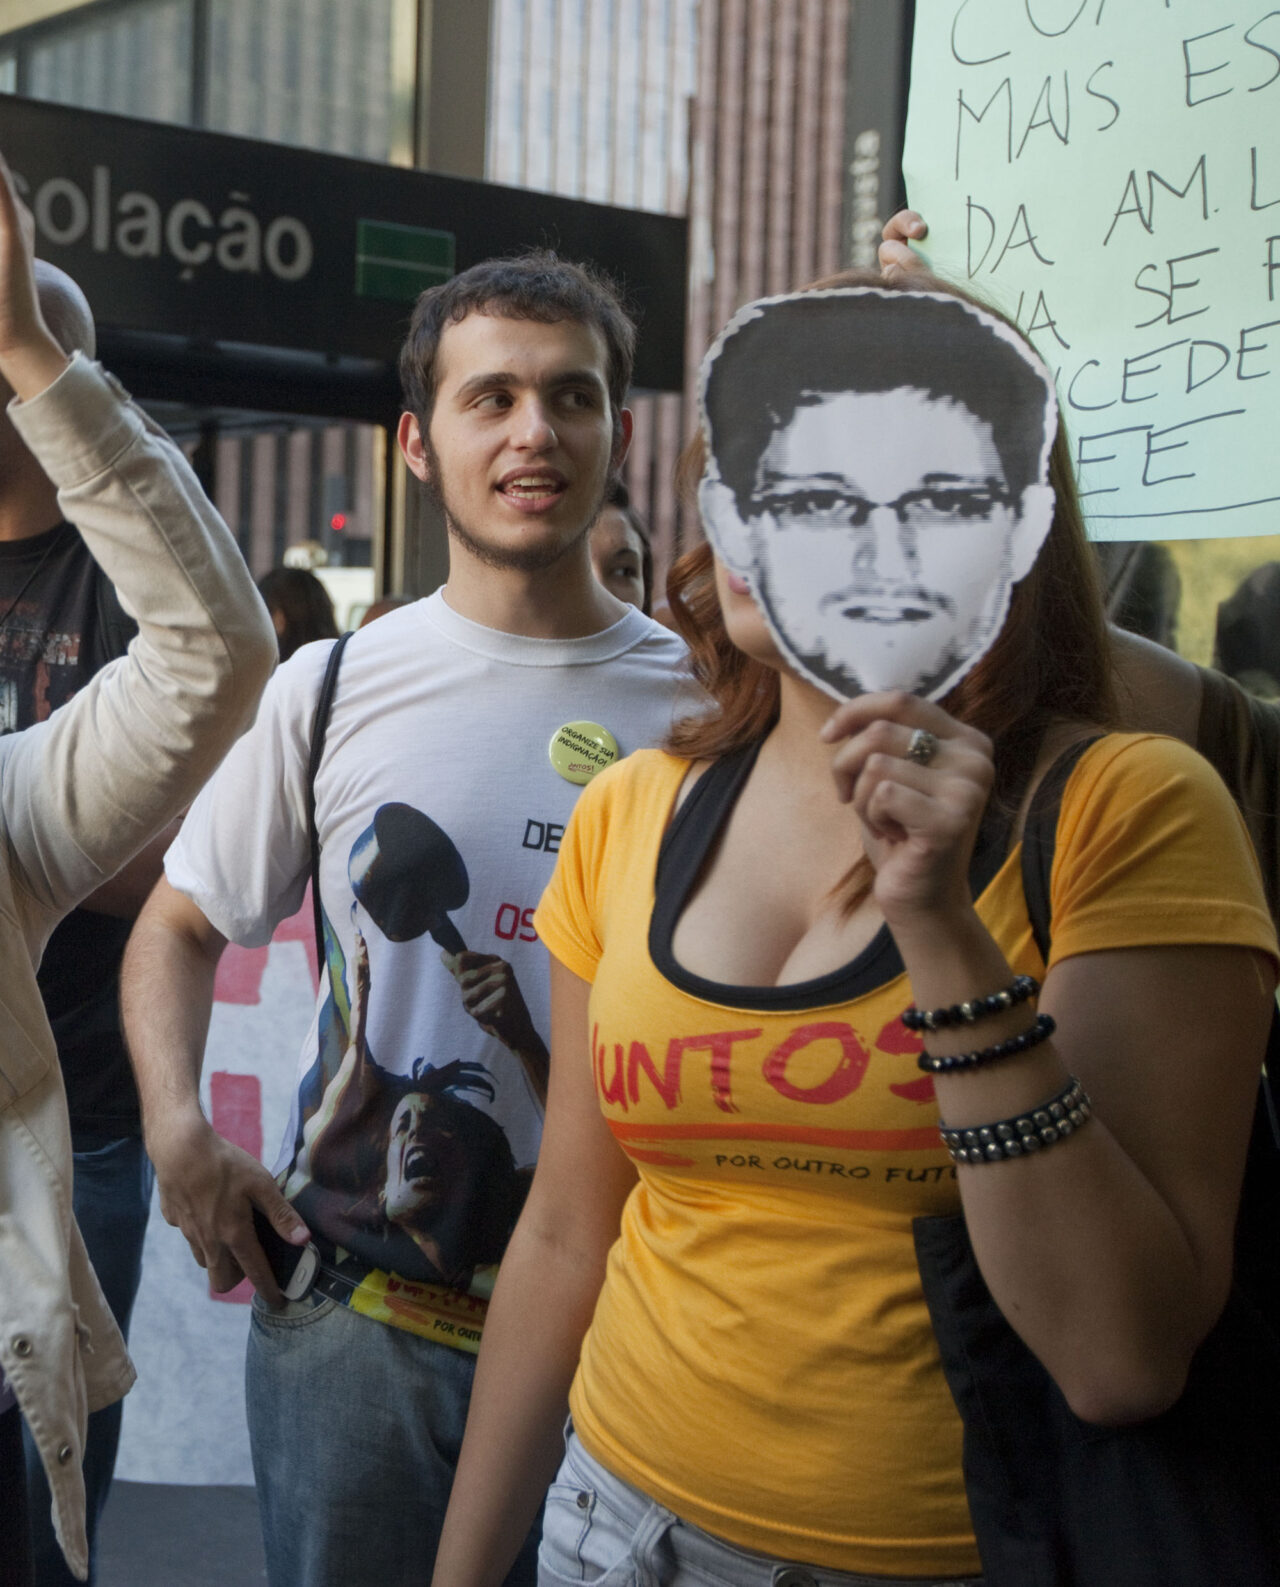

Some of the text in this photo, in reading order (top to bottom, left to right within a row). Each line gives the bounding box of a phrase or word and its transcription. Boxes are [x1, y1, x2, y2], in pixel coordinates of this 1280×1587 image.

[966, 195, 1055, 280] DA
[1134, 247, 1220, 328] SE
[1054, 321, 1280, 412] CEDE
[561, 726, 599, 750] ORGANIZE
[715, 1154, 762, 1170] POR
[772, 1156, 871, 1180] OUTRO
